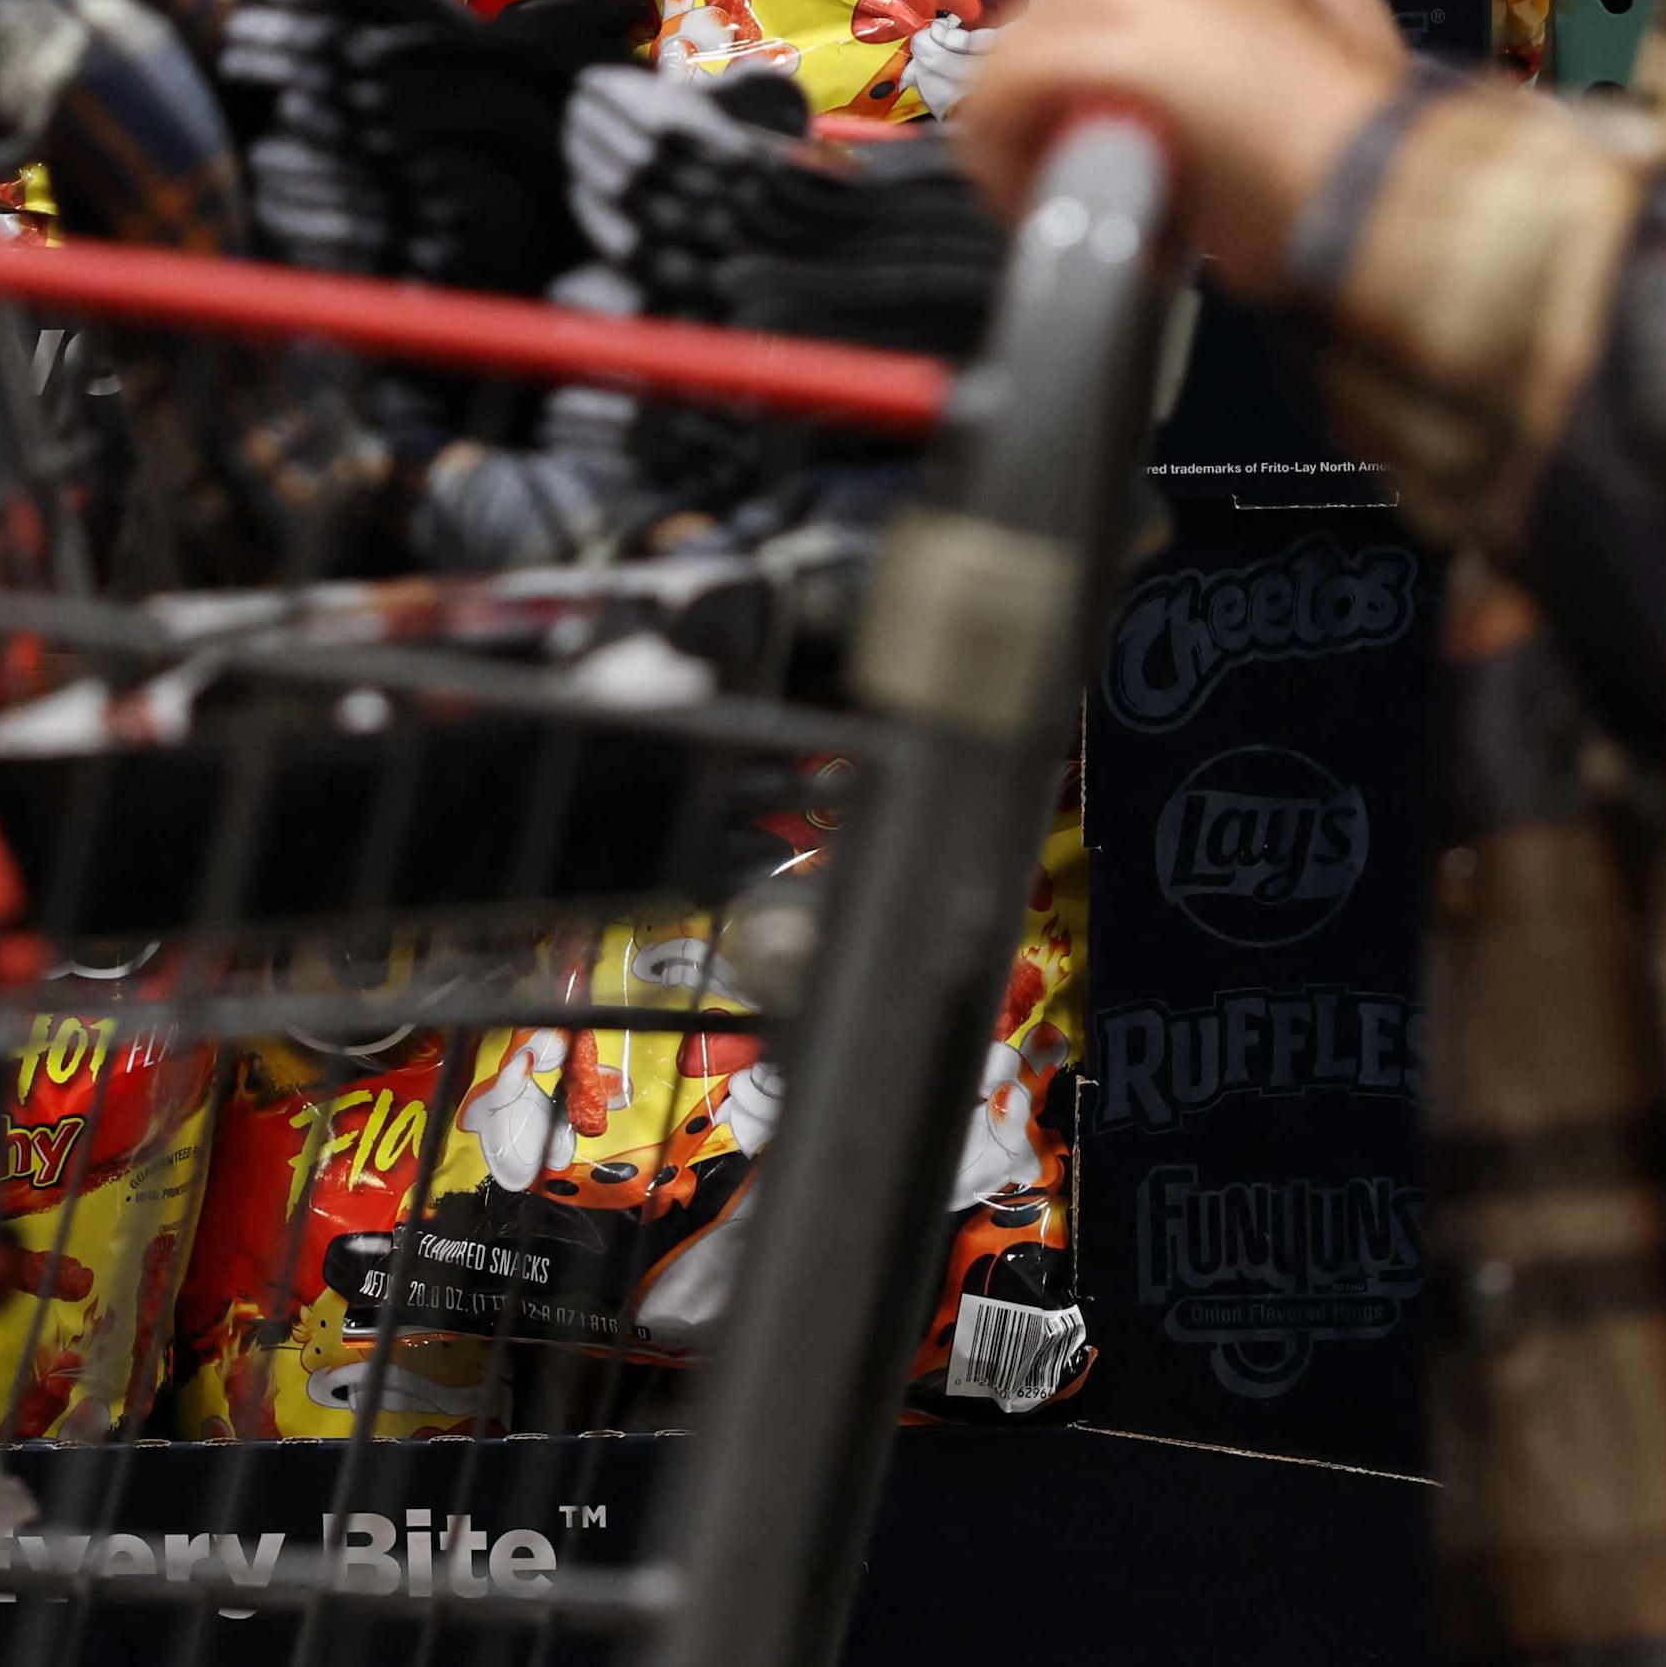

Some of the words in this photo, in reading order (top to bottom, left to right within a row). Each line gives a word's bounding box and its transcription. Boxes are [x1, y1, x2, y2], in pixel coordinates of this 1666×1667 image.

[1169, 463, 1243, 475] trademarks
[1245, 462, 1258, 474] of
[1260, 461, 1317, 476] Frito-Lay
[1319, 460, 1355, 473] North
[1108, 544, 1413, 729] Cheetos
[1170, 789, 1360, 904] Lay's
[417, 1233, 486, 1272] FLAVORED
[1189, 1304, 1244, 1325] Onion
[1247, 1302, 1329, 1325] Flavored
